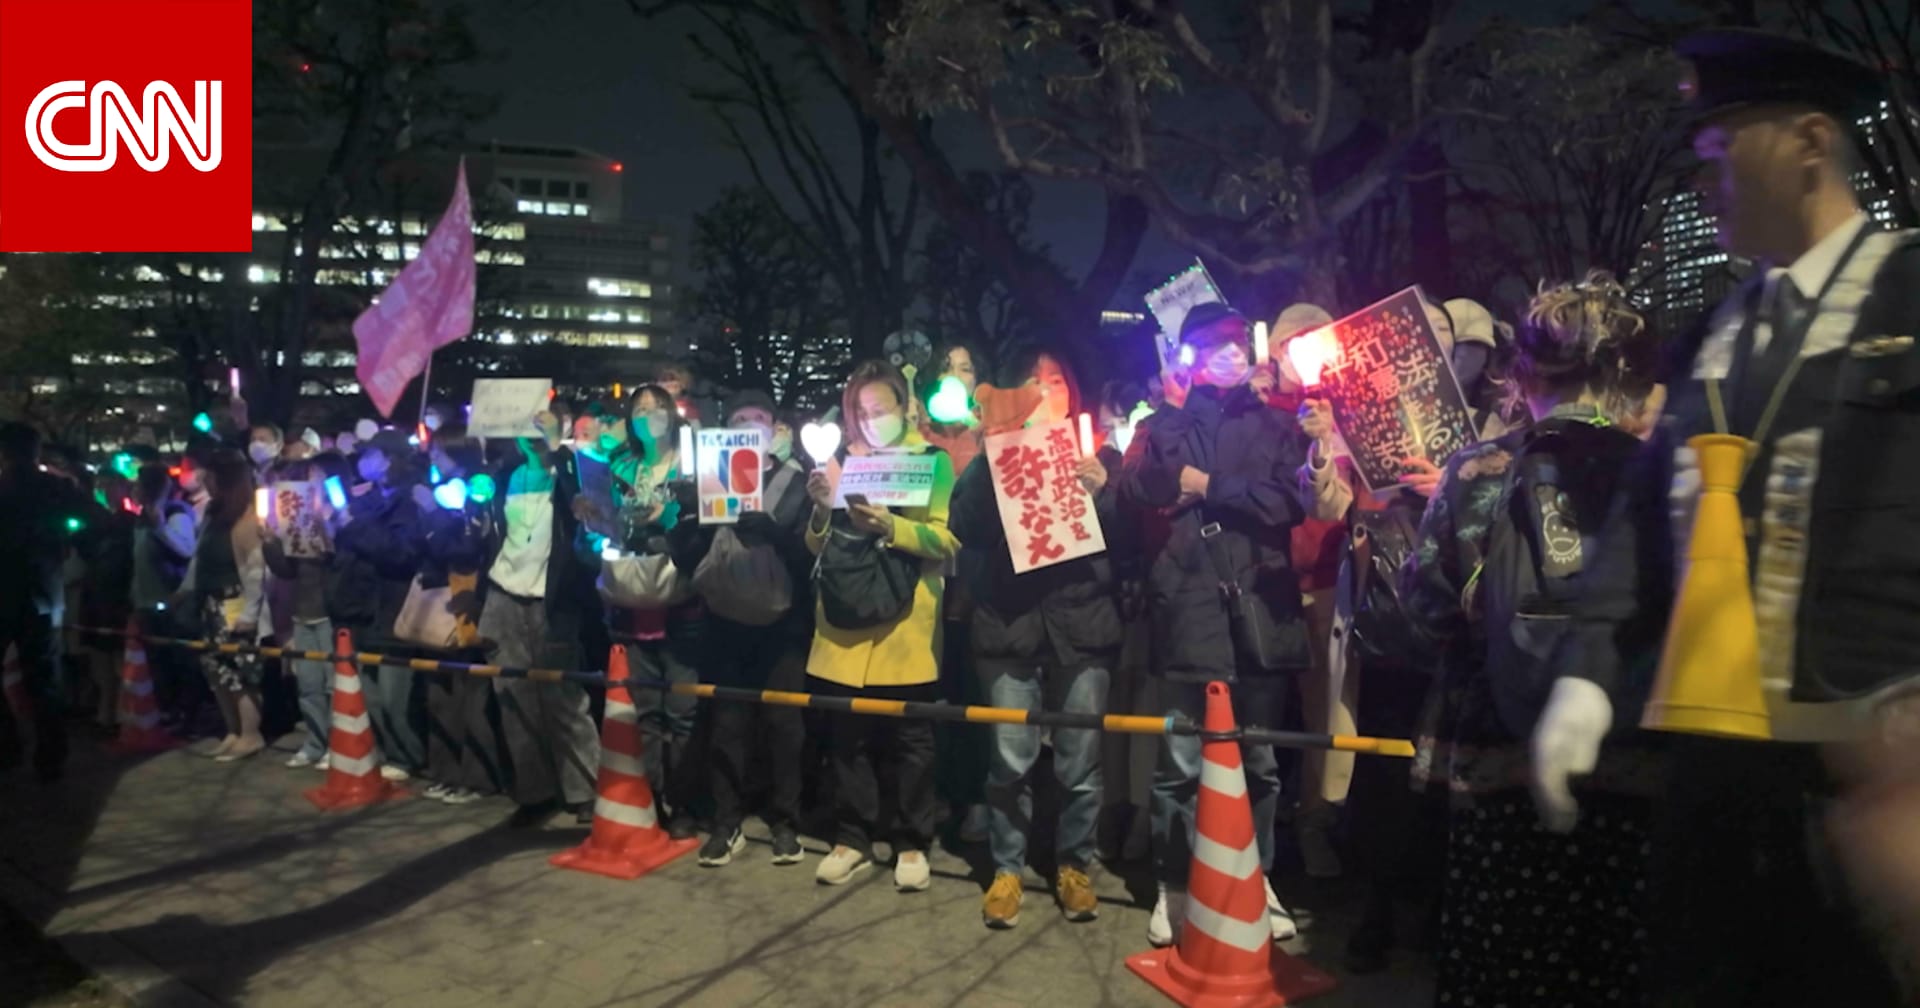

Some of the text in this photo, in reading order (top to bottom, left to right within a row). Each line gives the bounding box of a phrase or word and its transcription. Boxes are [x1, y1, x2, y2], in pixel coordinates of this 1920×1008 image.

[1323, 335, 1390, 387] 平和
[1367, 349, 1433, 401] 憲法
[701, 433, 759, 447] TAKAICHI
[702, 448, 760, 496] NO
[1045, 428, 1091, 541] 高市政治を
